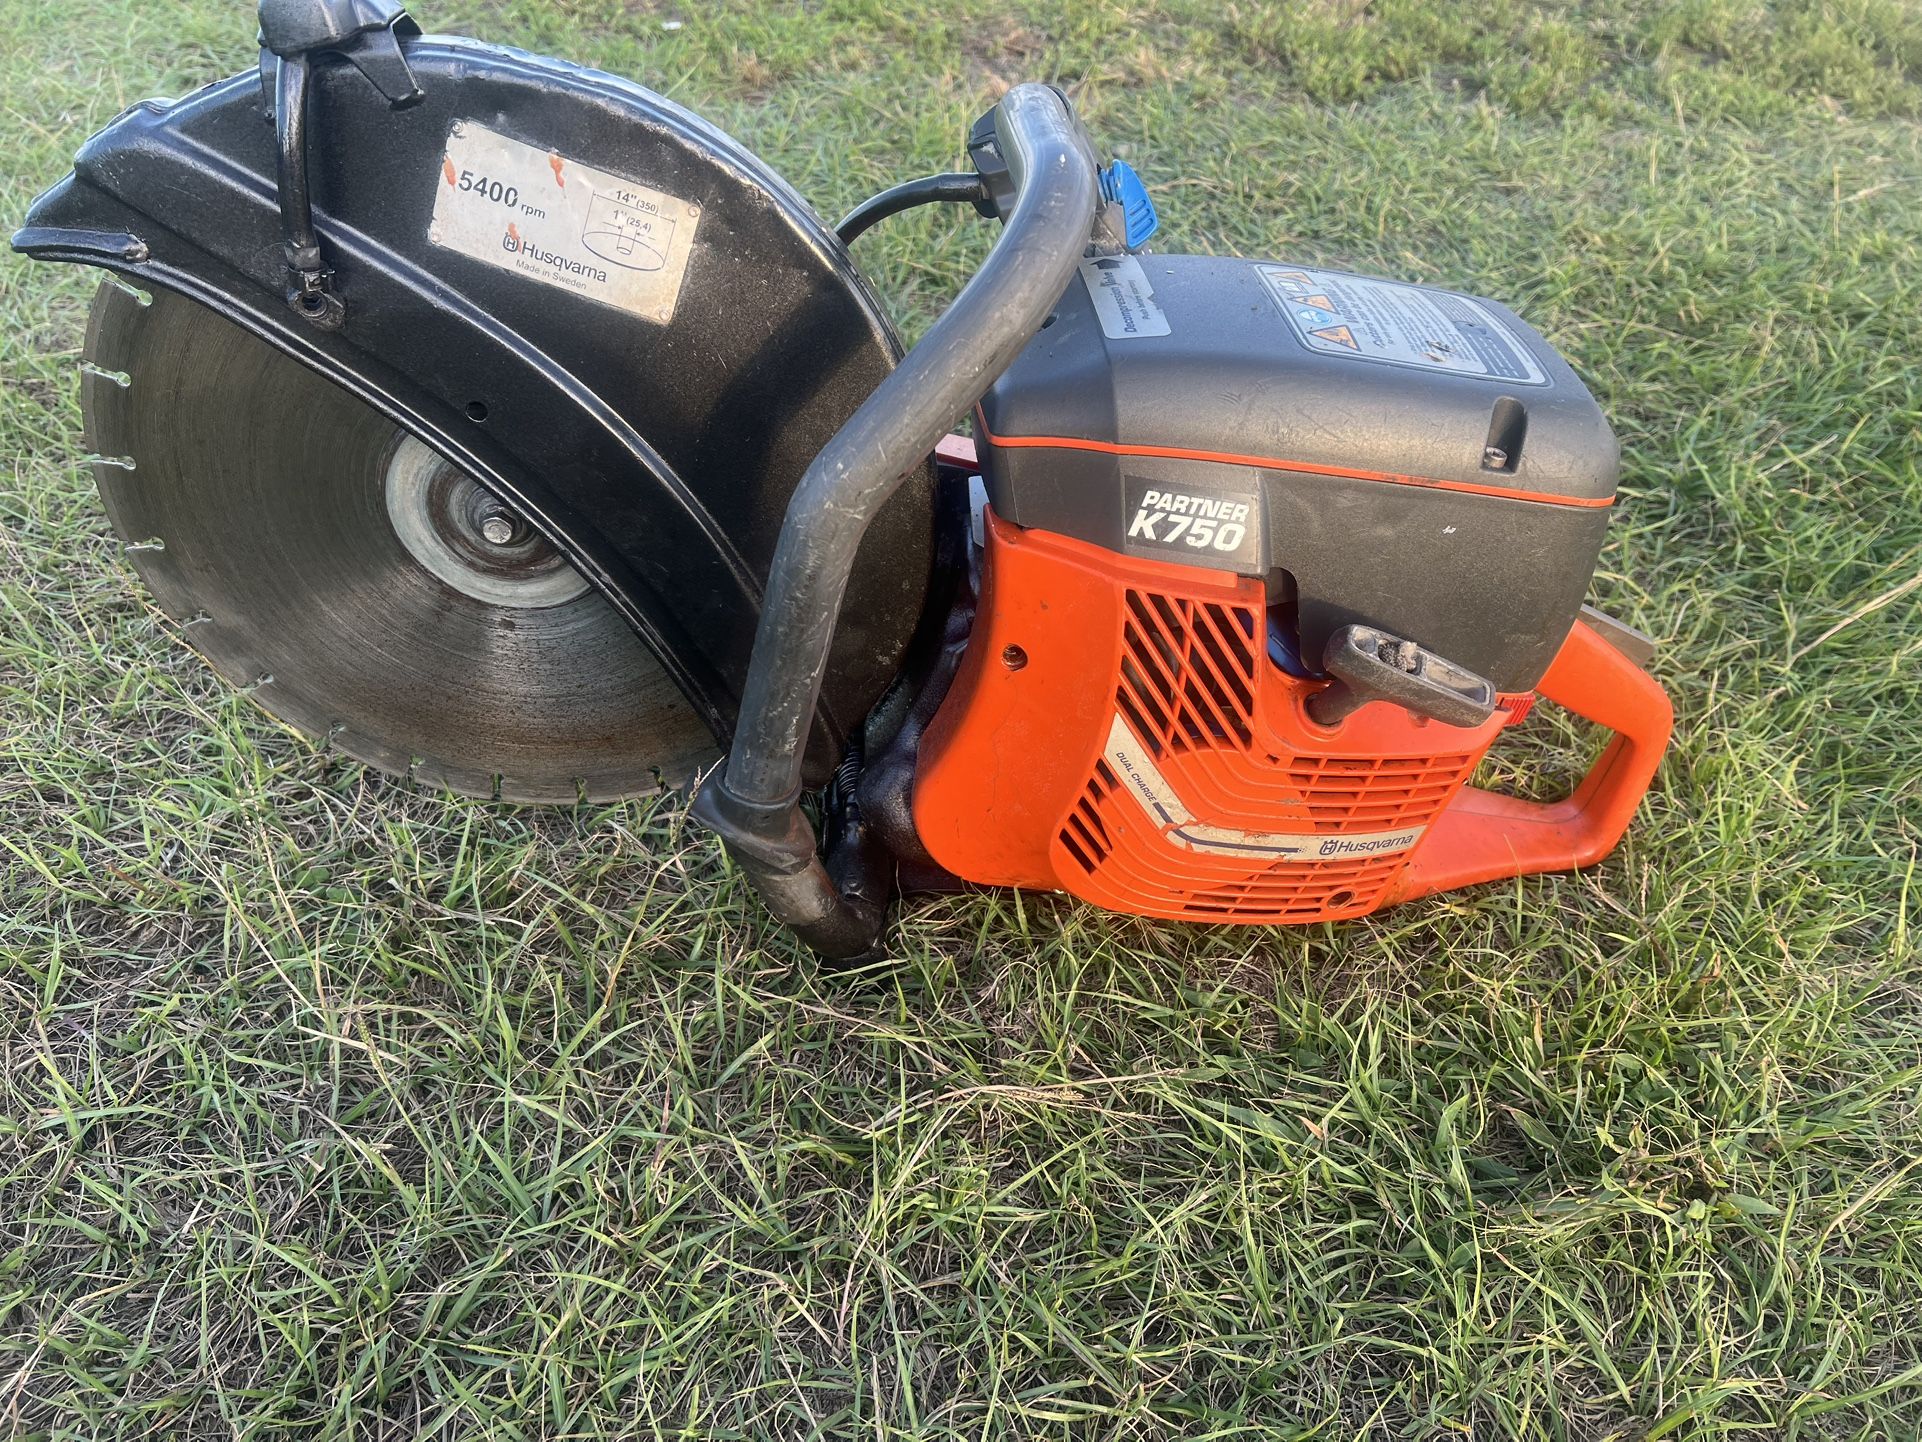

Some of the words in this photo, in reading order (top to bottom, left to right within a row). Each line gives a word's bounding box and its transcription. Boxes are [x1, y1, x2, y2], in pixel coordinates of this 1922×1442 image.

[458, 169, 519, 208] 5400
[520, 203, 546, 219] rpm
[515, 259, 541, 274] Made
[542, 268, 550, 278] in
[552, 272, 587, 290] Sweden
[521, 241, 607, 283] Husqvarna
[1110, 286, 1137, 333] Decompression
[1141, 490, 1250, 523] PARTNER
[1127, 509, 1246, 551] K750
[1116, 752, 1134, 773] DUAL
[1131, 772, 1157, 802] CHARGE
[1336, 834, 1414, 853] Husqvarna
